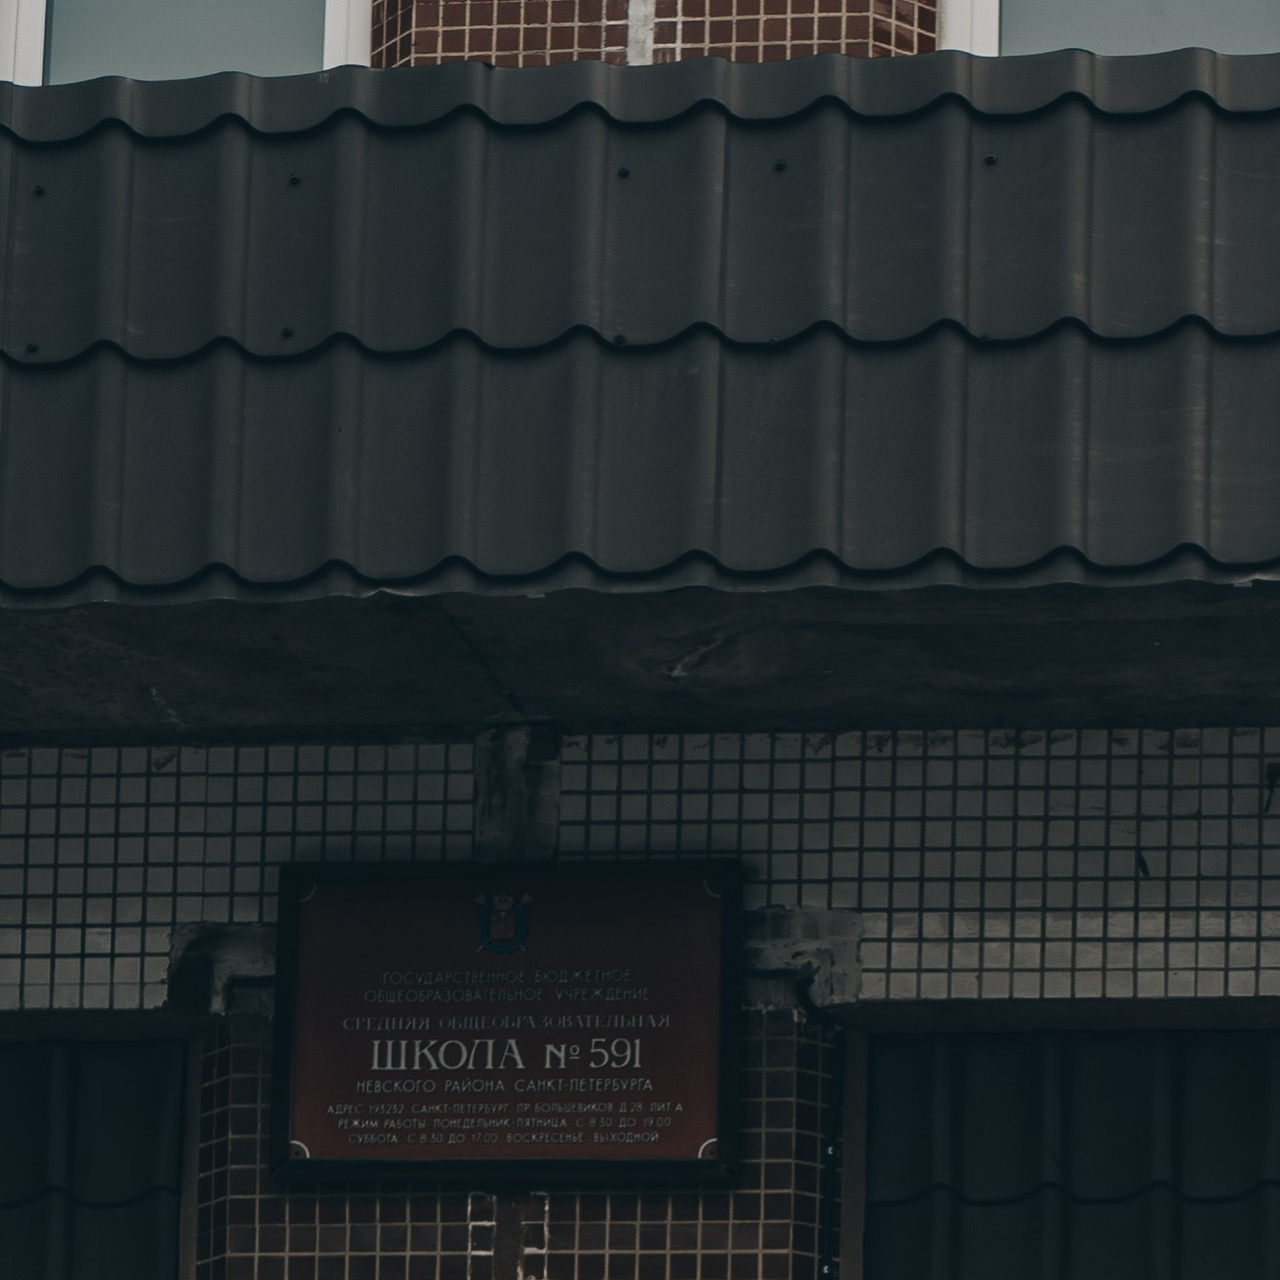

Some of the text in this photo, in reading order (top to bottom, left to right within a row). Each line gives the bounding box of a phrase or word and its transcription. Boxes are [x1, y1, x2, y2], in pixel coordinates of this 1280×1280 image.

[383, 968, 632, 985] ГОСУДАРСТВЕННОЕ БЮДЖЕТНОЕ
[363, 987, 650, 1003] ОБЩЕОБРАЗОВАТЕЛЬНОЕ УЧРЕЖДЕНИЕ
[342, 1014, 671, 1032] СРЕДНЯЯ ОБЩЕОБРАЗОВАТЕЛЬНАЯ
[370, 1038, 526, 1070] ШКОЛА
[589, 1038, 642, 1069] 591
[356, 1076, 654, 1093] НЕВСКОГО РАЙОНА САНКТ-ПЕТЕРБУРГА
[337, 1118, 379, 1130] РЕЖИМ
[619, 1117, 638, 1128] ДО
[448, 1132, 467, 1144] ДО
[593, 1130, 660, 1143] ВЫХОДНОЙ
